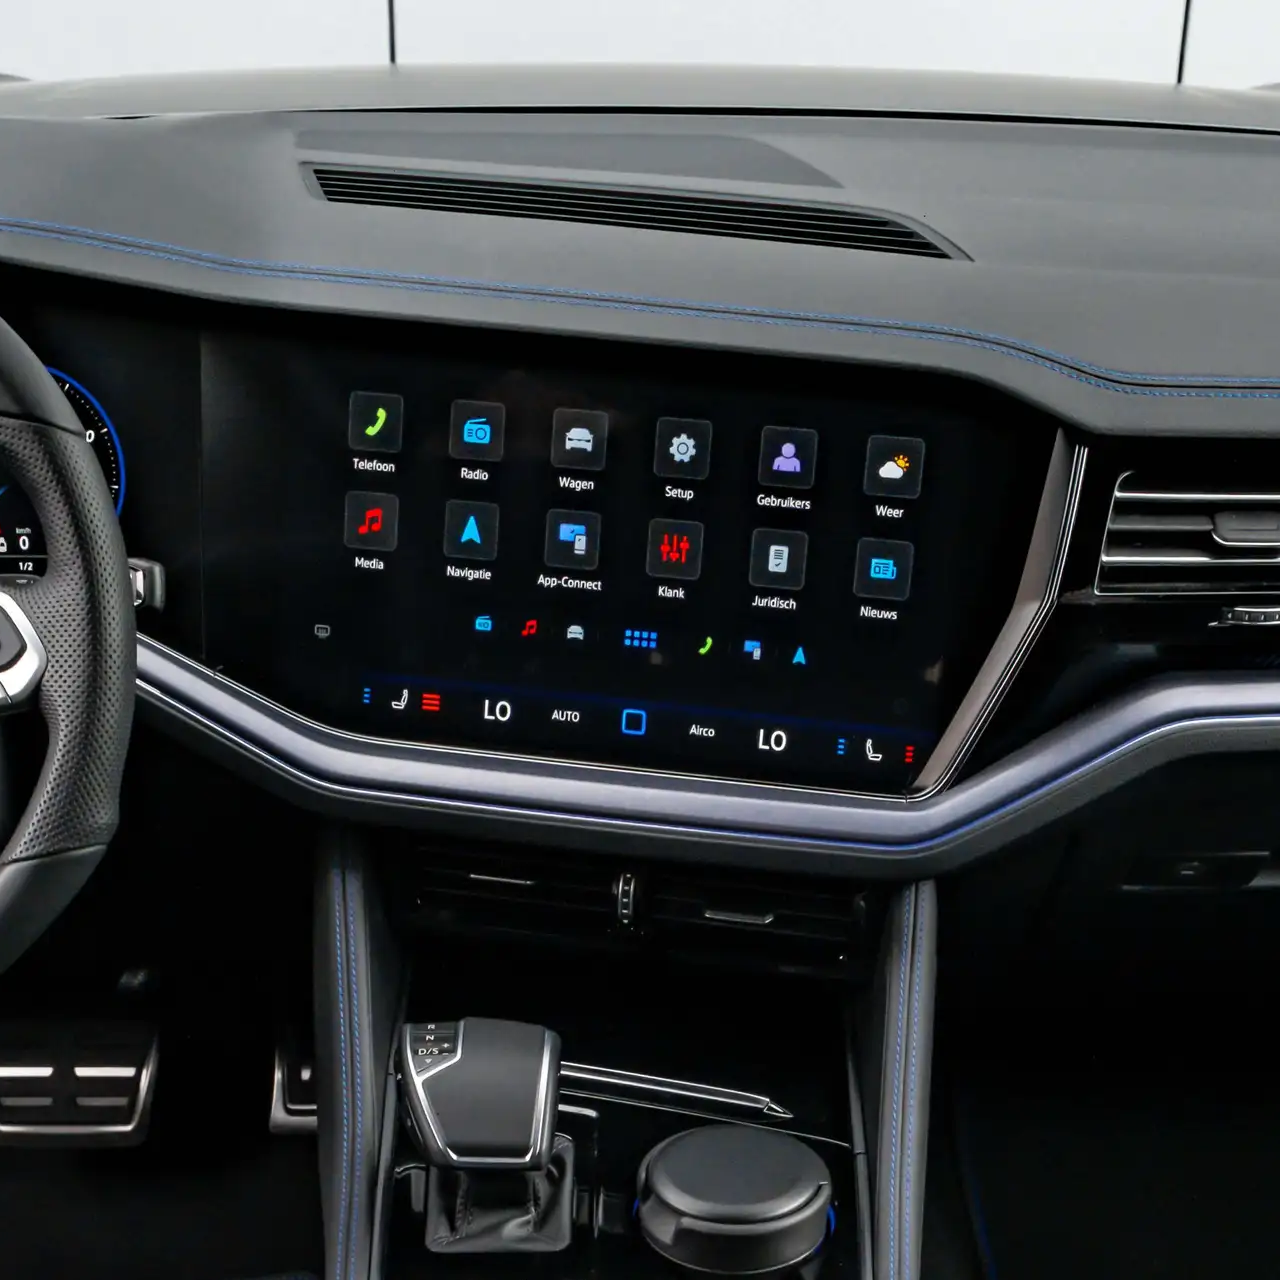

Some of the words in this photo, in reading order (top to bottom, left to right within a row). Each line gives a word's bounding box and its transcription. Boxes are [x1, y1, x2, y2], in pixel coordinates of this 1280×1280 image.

[353, 458, 395, 472] Telefoon
[461, 468, 488, 480] Radio
[559, 477, 594, 491] Wagen
[665, 486, 693, 500] Setup
[757, 494, 810, 509] Gebruikers
[876, 505, 904, 517] Weer
[19, 536, 29, 550] 0
[19, 562, 33, 570] 1/2
[355, 557, 384, 569] Media
[447, 566, 491, 580] Navigatie
[538, 574, 601, 590] App-Connect
[658, 586, 684, 598] Klank
[752, 596, 796, 609] Juridisch
[860, 606, 897, 619] Nieuws
[484, 700, 511, 721] LO
[552, 710, 579, 722] AUTO
[690, 724, 715, 736] Airco
[759, 729, 786, 751] LO
[418, 1047, 439, 1056] D/S
